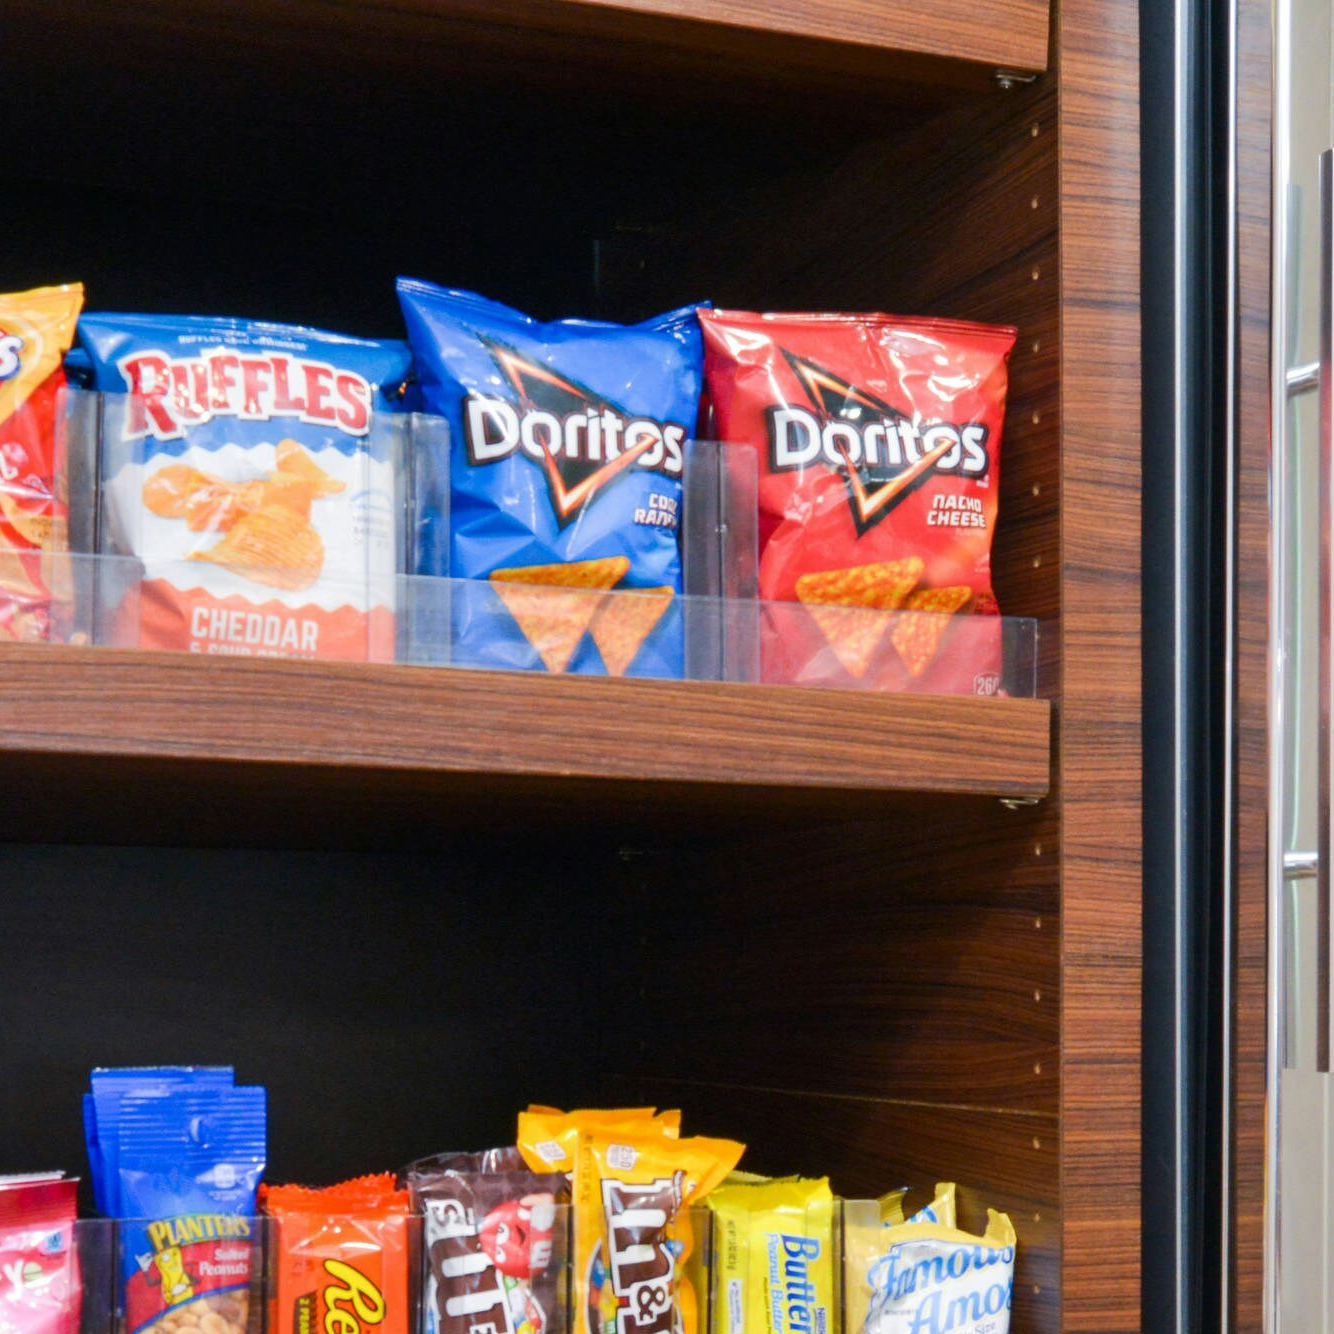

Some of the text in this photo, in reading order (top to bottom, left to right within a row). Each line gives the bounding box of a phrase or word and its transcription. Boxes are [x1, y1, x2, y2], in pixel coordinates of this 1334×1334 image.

[125, 355, 369, 435] RUFFLES
[467, 398, 684, 473] Doritos
[774, 408, 987, 473] Doritos
[927, 511, 986, 527] CHEESE
[933, 495, 982, 511] NACHO
[190, 606, 319, 651] CHEDDAR
[148, 1212, 251, 1250] PLANTERS
[198, 1260, 249, 1277] Peanuts
[214, 1246, 250, 1263] Salted
